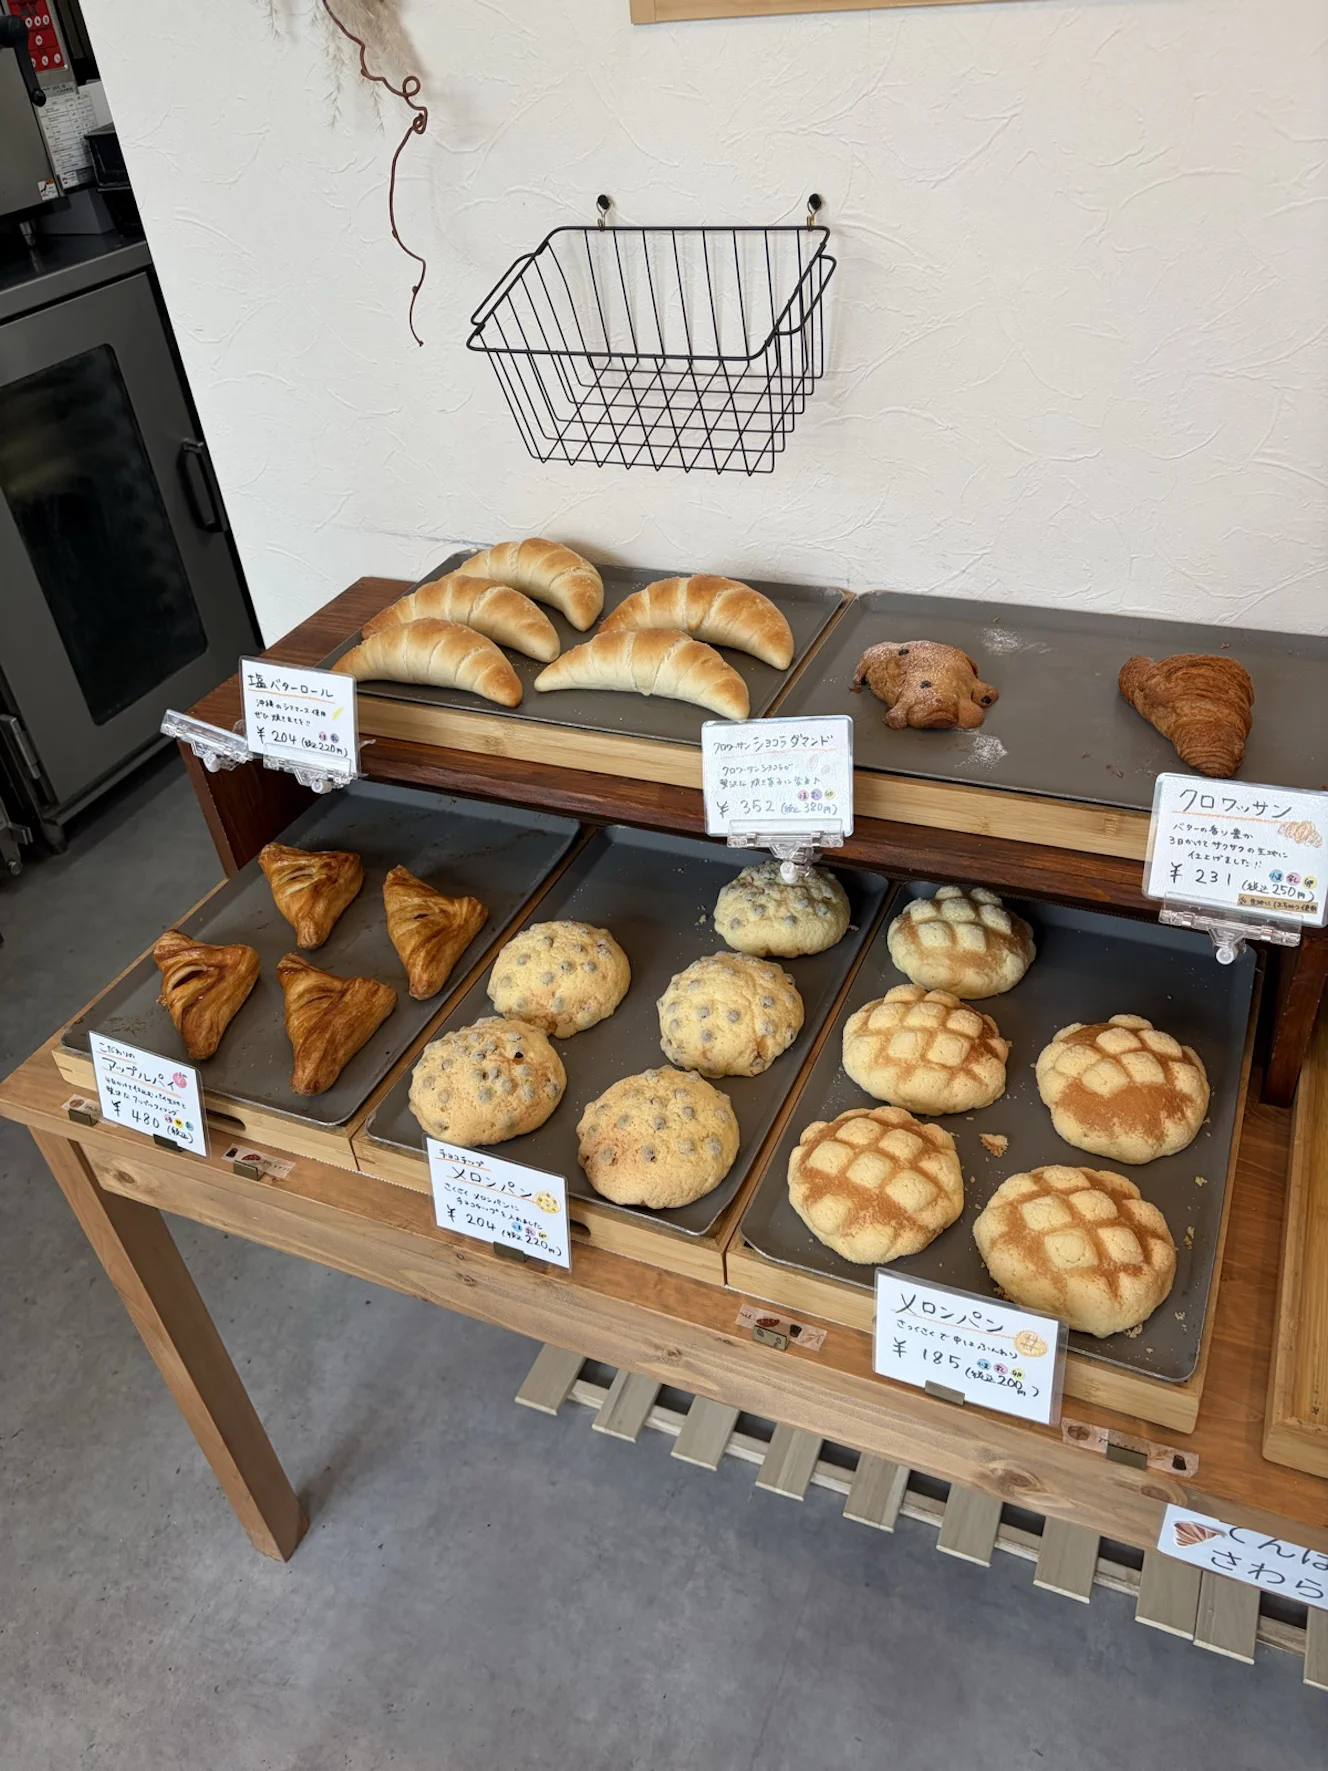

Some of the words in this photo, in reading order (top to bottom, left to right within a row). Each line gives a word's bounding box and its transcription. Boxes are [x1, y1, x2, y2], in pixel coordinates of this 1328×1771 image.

[248, 672, 333, 697] 塩バターロール
[1180, 789, 1292, 818] クロワッサン
[1173, 823, 1254, 840] バターの香り豊か
[102, 1056, 175, 1091] アップルパイ
[452, 1166, 532, 1198] メロンパン
[896, 1293, 1004, 1333] メロンパン
